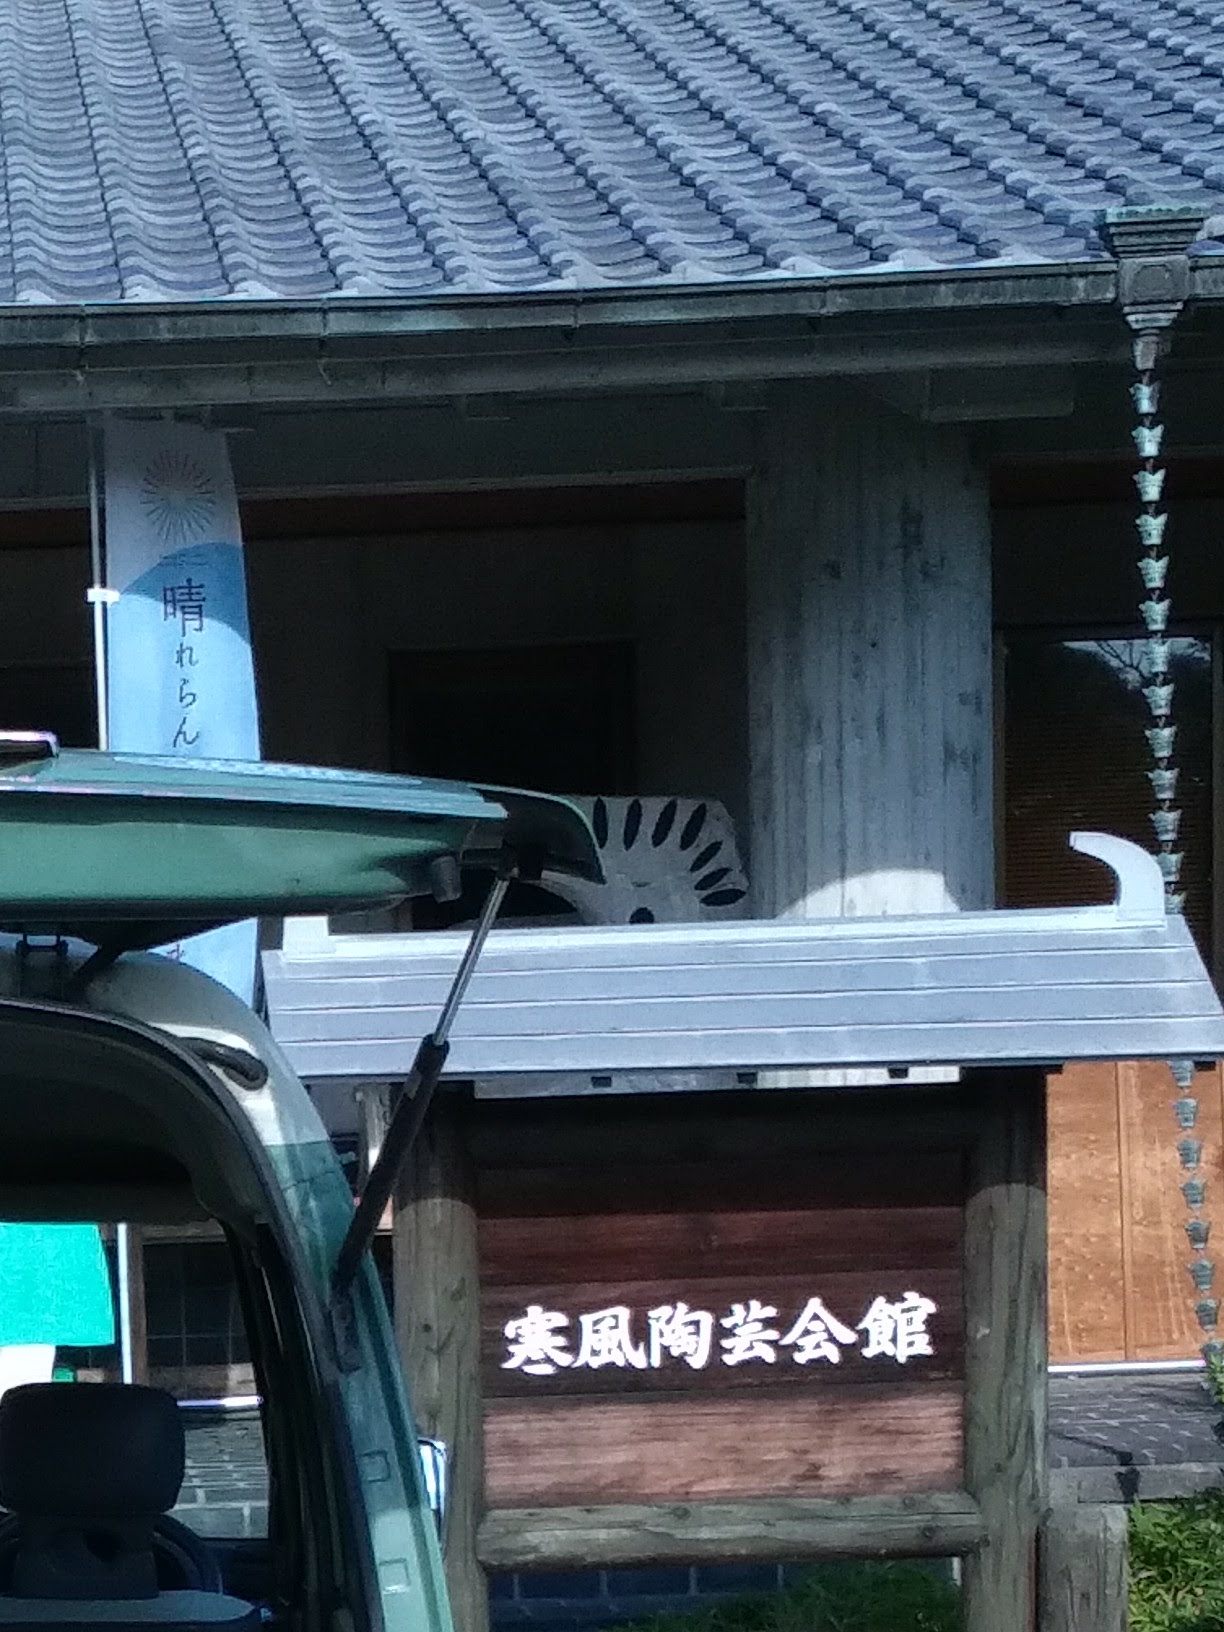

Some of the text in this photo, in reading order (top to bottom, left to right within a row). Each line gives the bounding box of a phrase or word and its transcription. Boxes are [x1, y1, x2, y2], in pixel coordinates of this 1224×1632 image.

[162, 577, 207, 748] 晴れらん
[501, 1292, 940, 1376] 寒風陶芸会館
